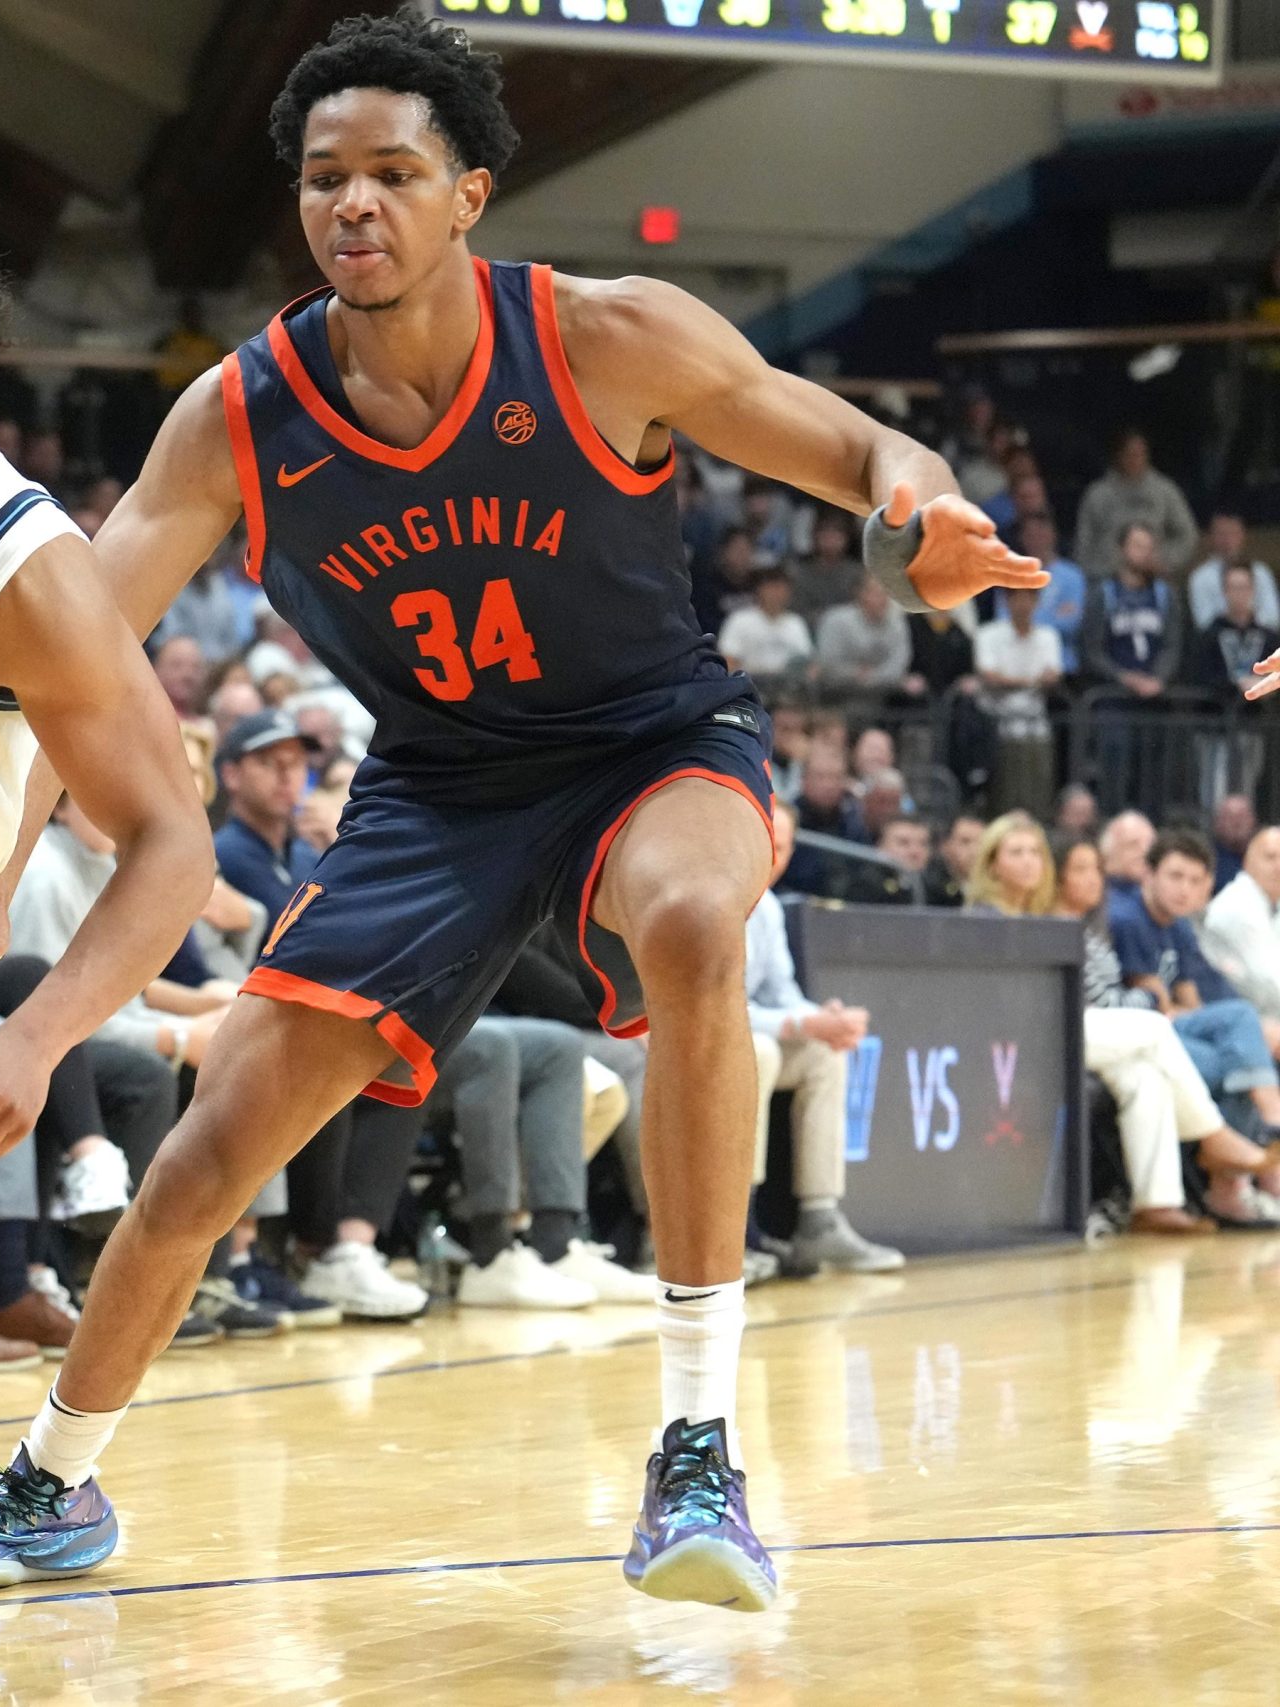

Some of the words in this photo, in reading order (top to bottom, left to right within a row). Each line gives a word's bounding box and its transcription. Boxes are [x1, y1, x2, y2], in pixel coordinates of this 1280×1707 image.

[319, 496, 566, 592] VIRGINIA
[390, 577, 543, 702] 34
[906, 1045, 961, 1151] VS
